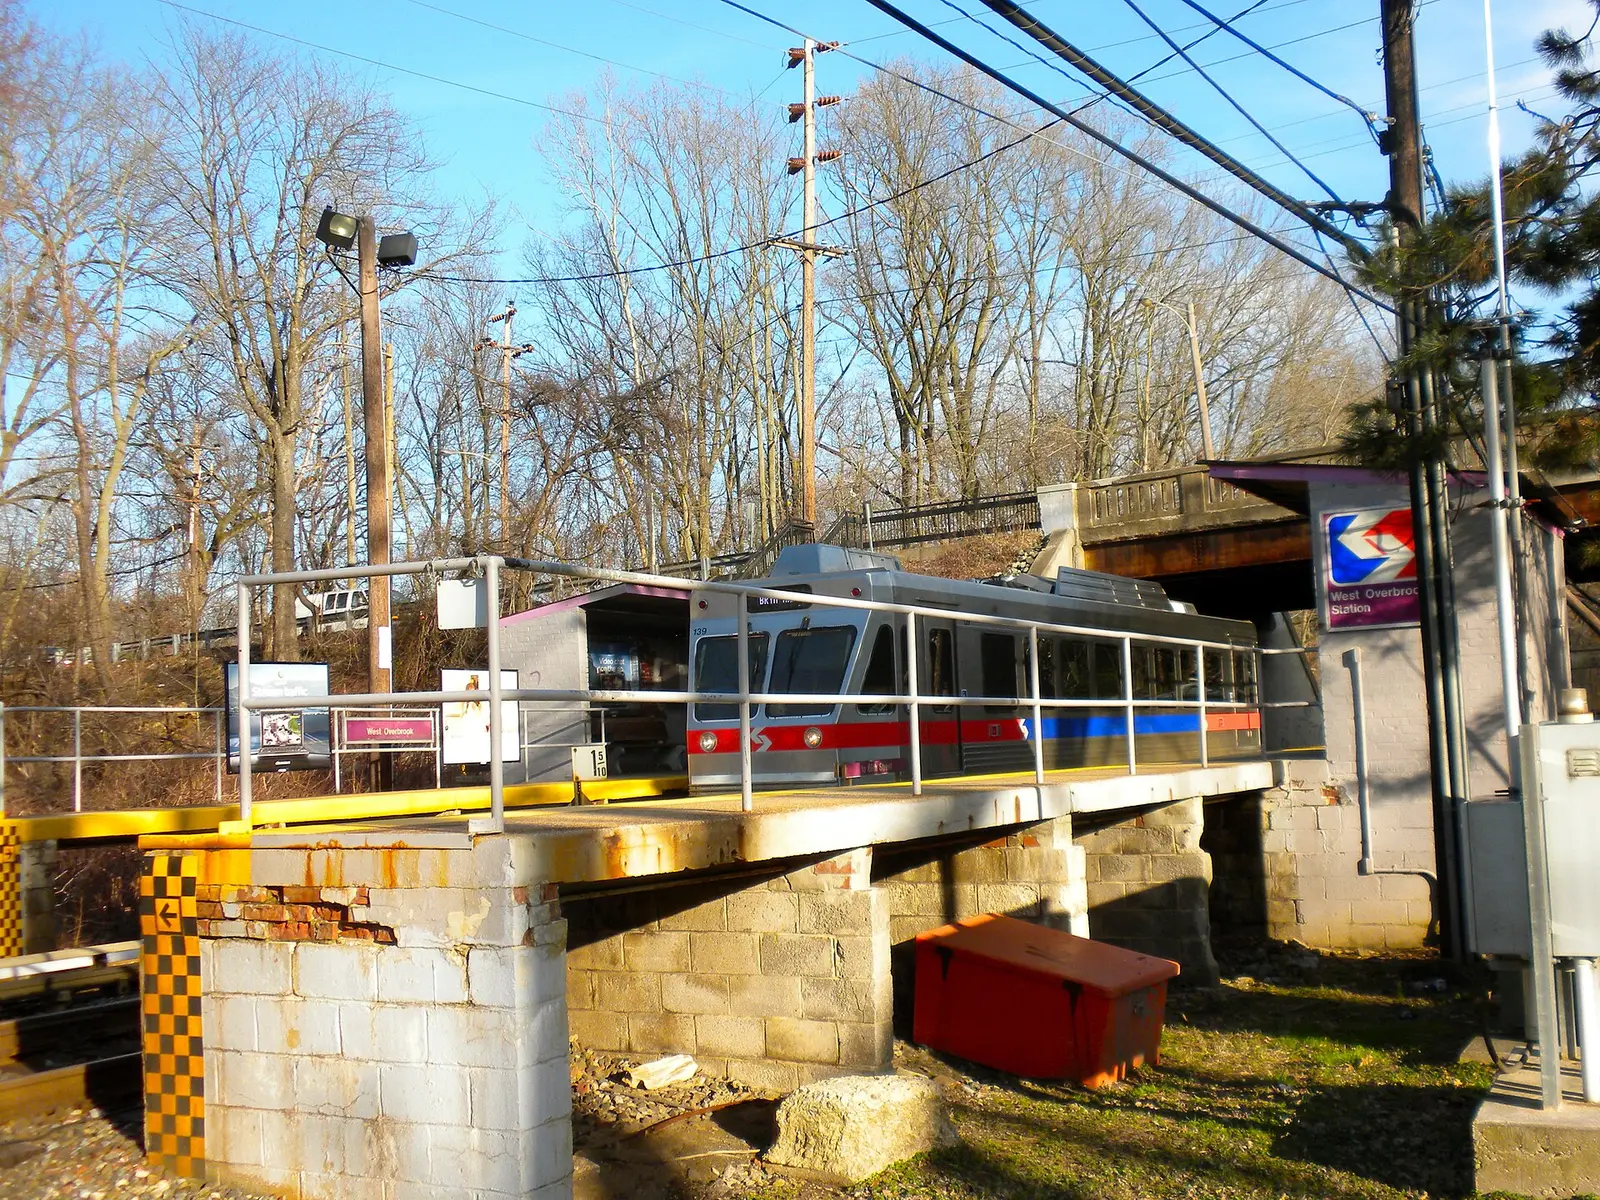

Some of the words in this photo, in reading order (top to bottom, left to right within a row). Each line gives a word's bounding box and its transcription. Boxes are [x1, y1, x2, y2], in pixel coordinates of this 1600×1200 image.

[1331, 590, 1360, 602] West
[1365, 587, 1419, 599] Overbroo
[1331, 604, 1371, 615] Station
[693, 627, 707, 636] 139
[366, 727, 382, 736] West
[383, 727, 414, 736] Overbrook
